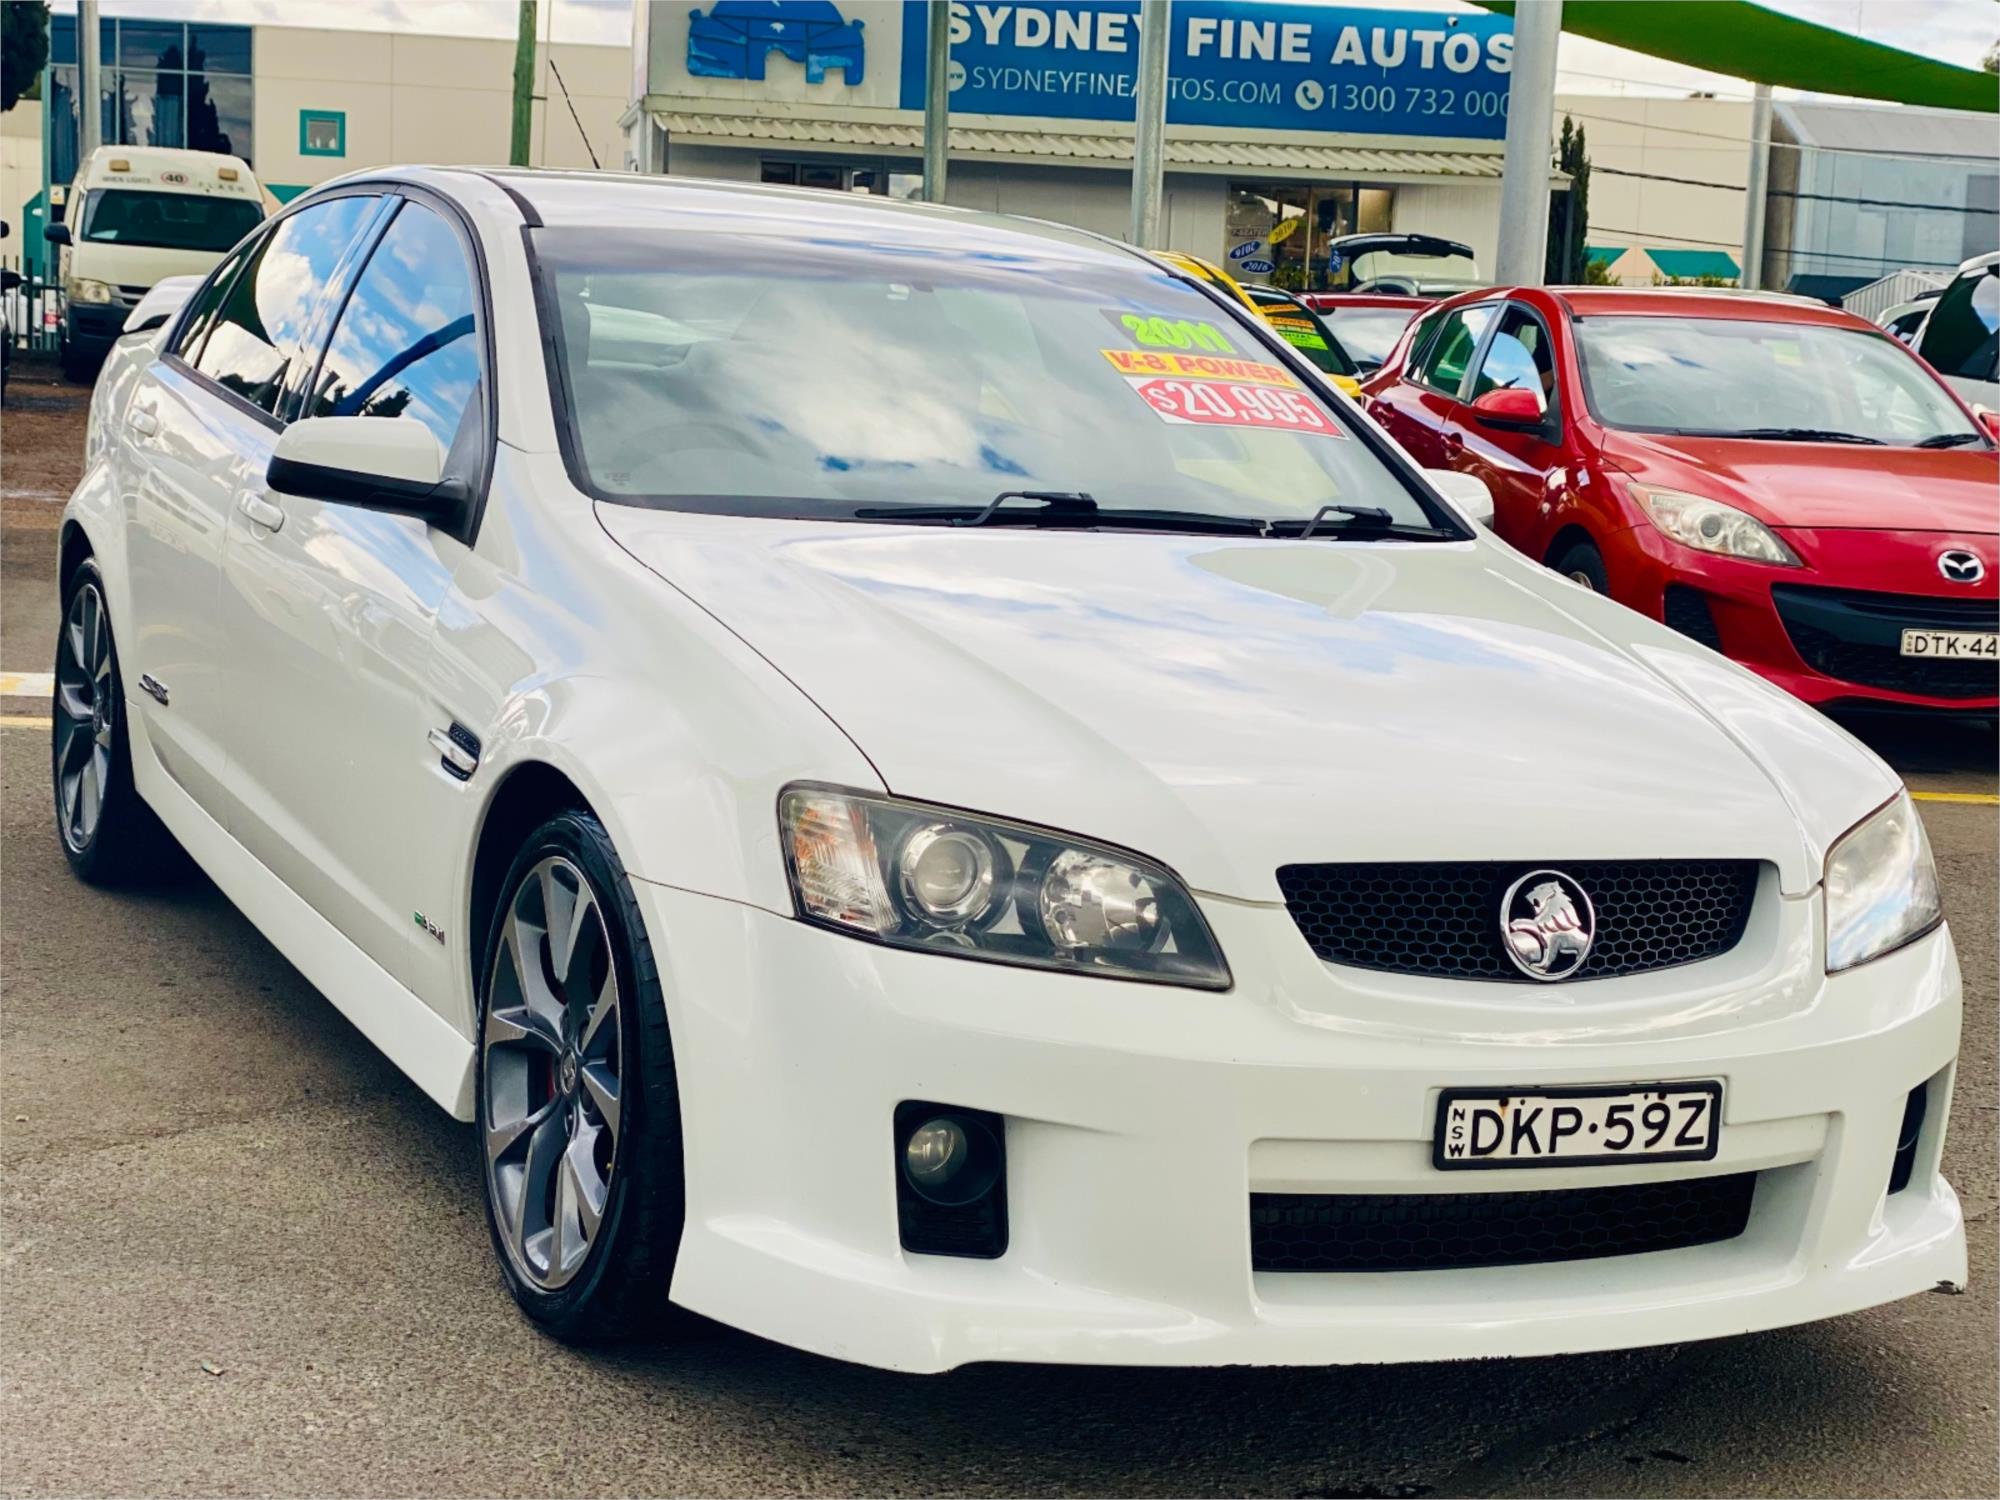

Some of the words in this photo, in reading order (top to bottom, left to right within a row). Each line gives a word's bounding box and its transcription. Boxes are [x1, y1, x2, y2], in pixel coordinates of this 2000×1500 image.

[950, 3, 1142, 52] SYDNE
[1187, 17, 1312, 63] FINE
[1330, 25, 1513, 73] AUTOS
[972, 66, 1281, 104] SYDNEYFINETOS.COM
[1327, 83, 1396, 112] 1300
[1405, 88, 1455, 115] 732
[166, 174, 184, 183] 40
[1246, 261, 1269, 271] 2016
[1121, 314, 1238, 355] 2011
[1110, 351, 1168, 372] V-8
[1175, 355, 1291, 383] POWER
[1147, 381, 1325, 428] $20,995
[1448, 1107, 1466, 1158] NSW
